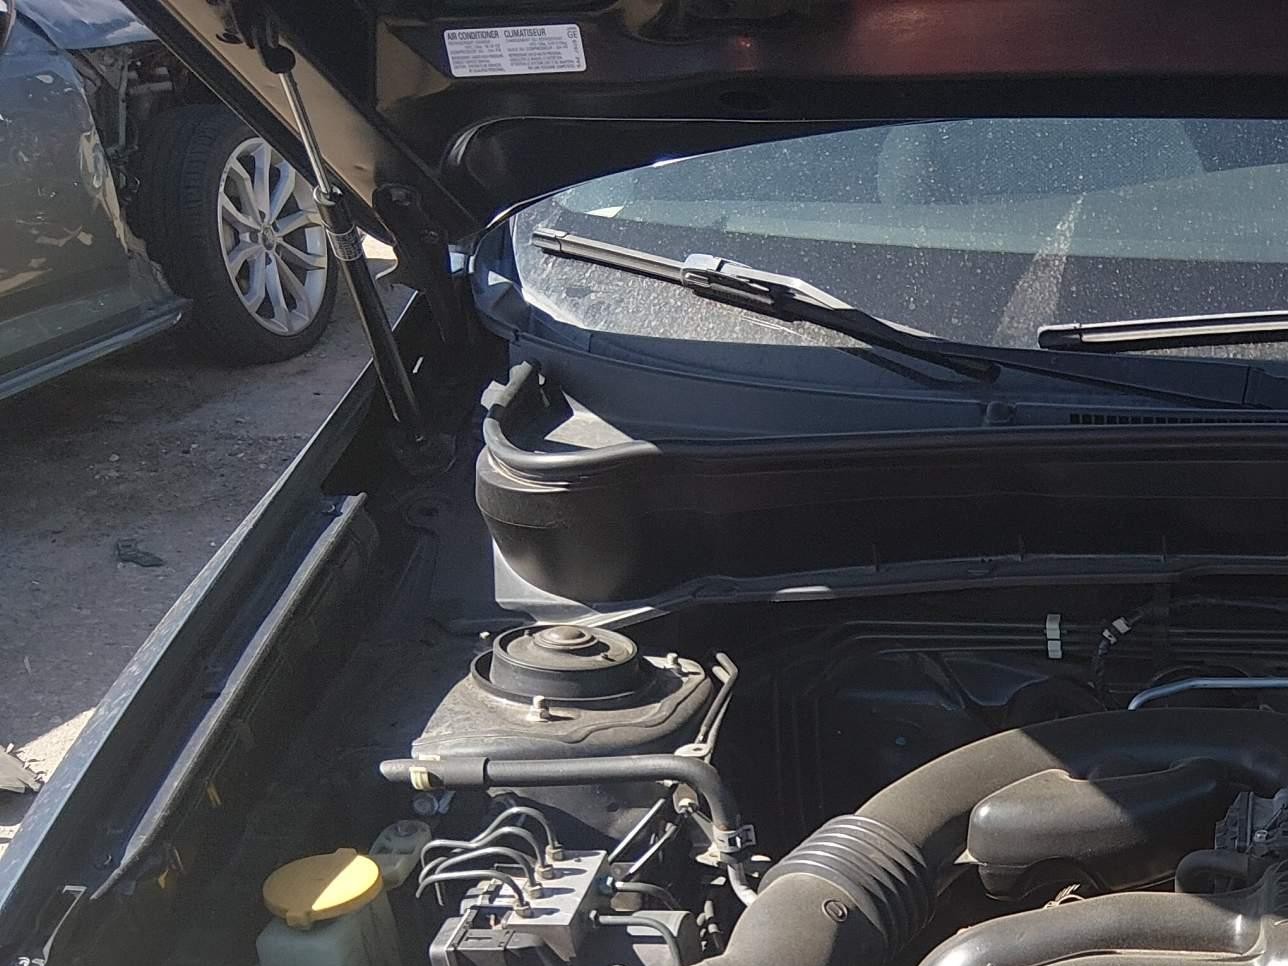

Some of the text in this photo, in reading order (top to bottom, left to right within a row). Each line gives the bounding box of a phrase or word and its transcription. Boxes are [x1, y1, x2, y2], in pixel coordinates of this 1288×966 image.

[447, 30, 500, 40] AIR CONDITIONER
[503, 28, 547, 38] CLIMATISEUR
[567, 30, 578, 39] GE
